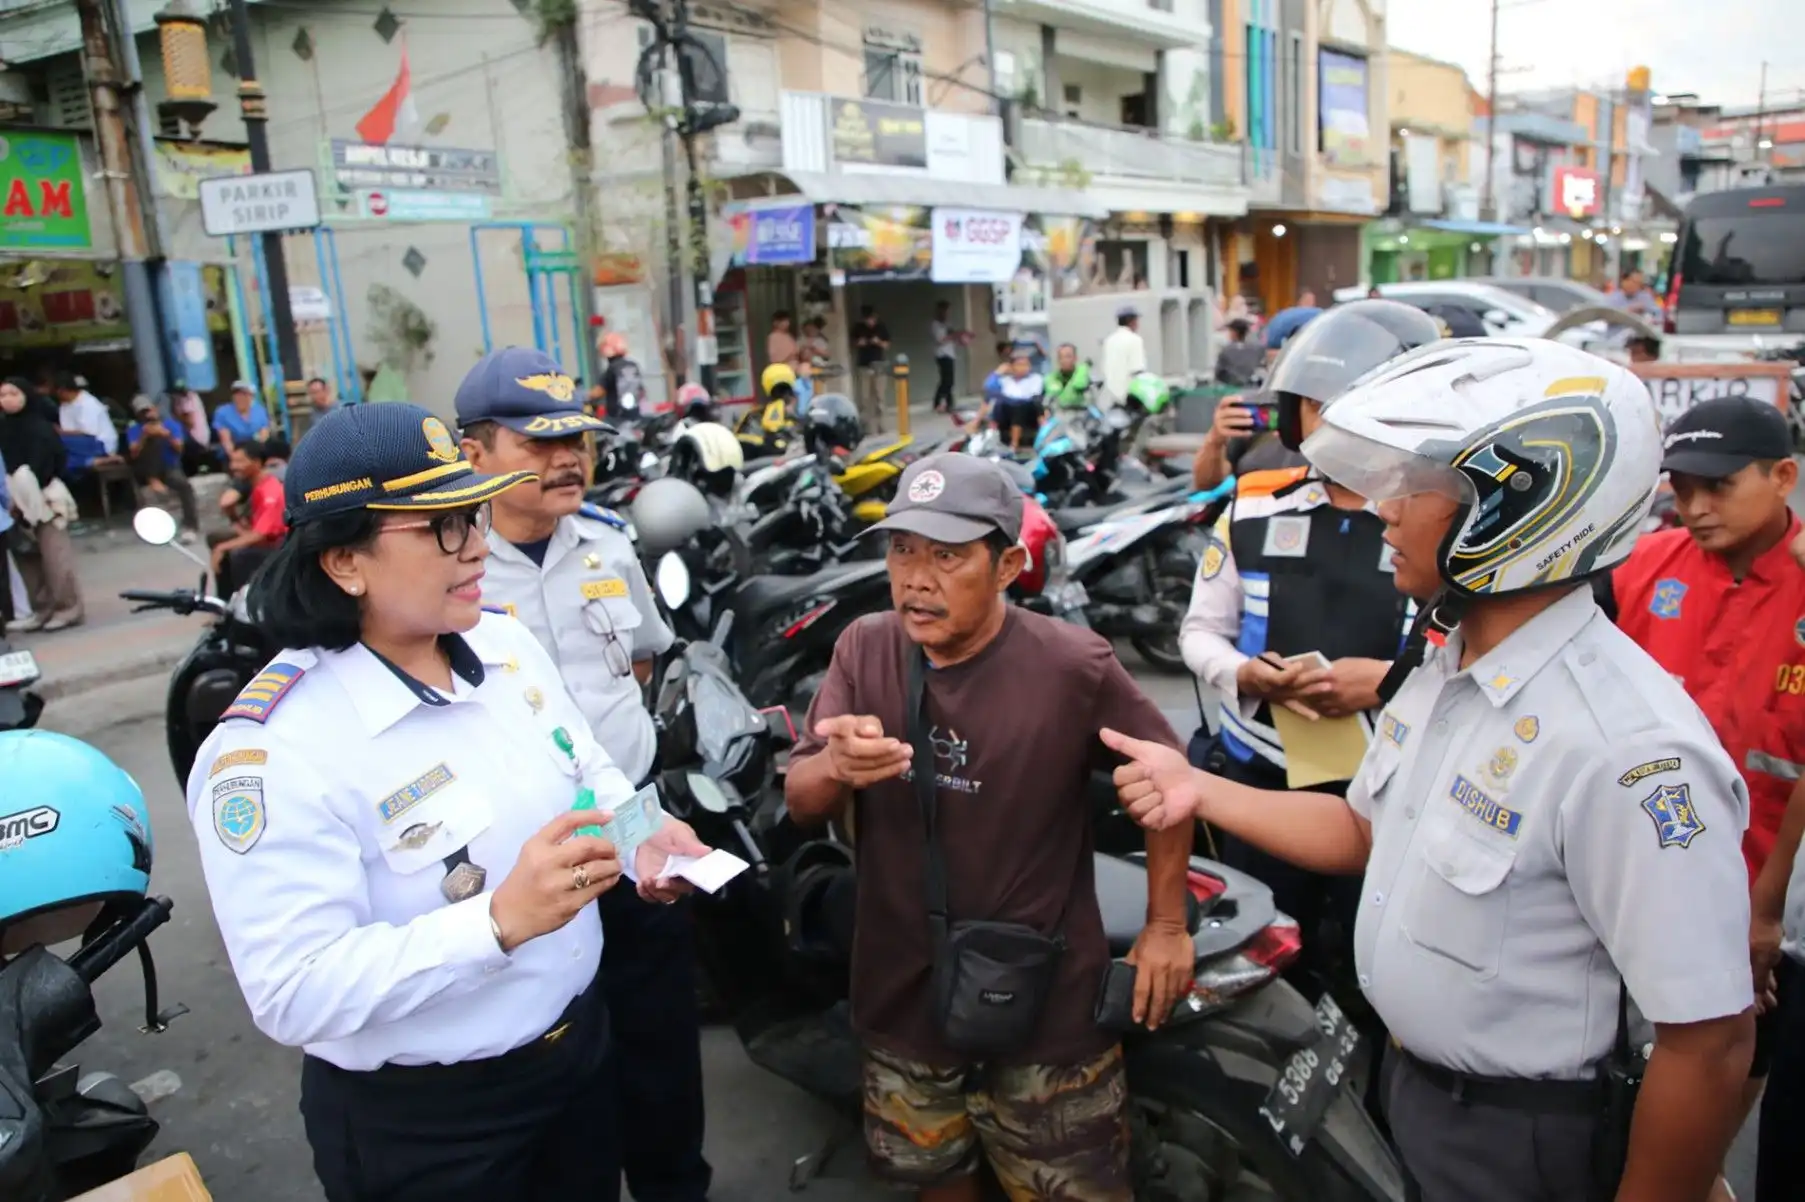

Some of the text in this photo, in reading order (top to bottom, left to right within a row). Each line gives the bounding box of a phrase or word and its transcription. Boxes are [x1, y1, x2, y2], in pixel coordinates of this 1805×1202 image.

[220, 180, 298, 204] PARKIR
[232, 203, 289, 225] SIRIP
[304, 477, 373, 504] PERHUBUNGAN
[1535, 522, 1596, 571] SAFETY RIDE
[1776, 664, 1805, 695] 03
[1455, 780, 1511, 831] DISHUB
